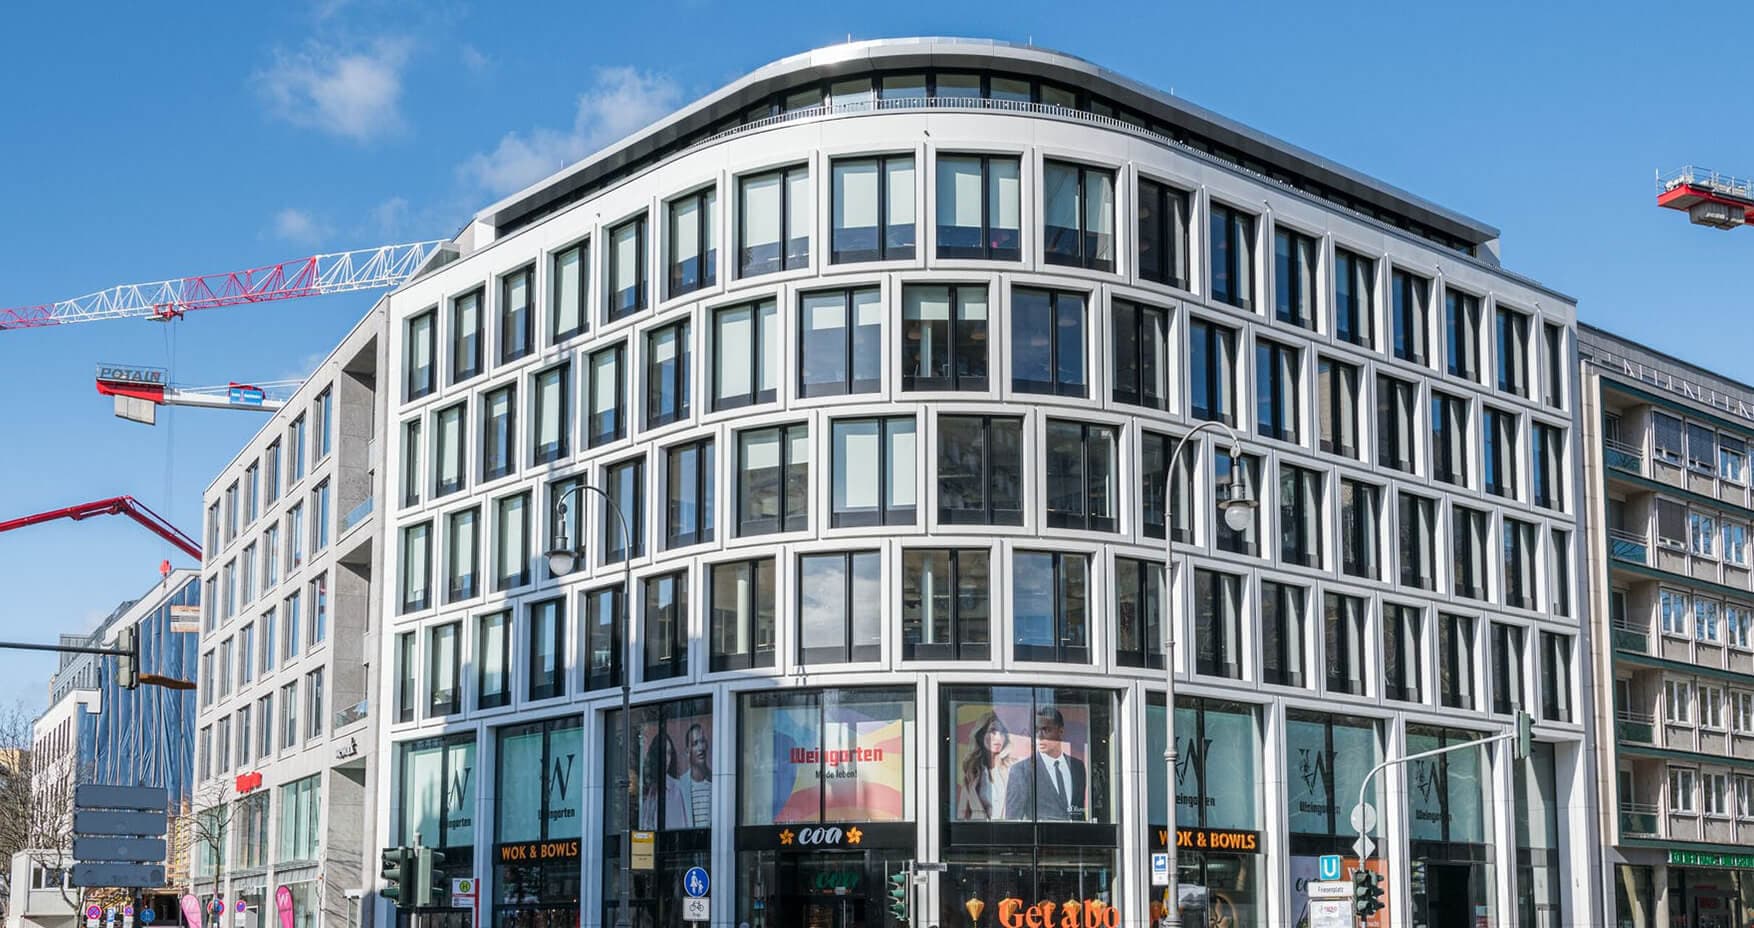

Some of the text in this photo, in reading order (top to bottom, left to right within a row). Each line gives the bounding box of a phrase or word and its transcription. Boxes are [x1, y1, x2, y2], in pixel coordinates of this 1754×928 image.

[100, 366, 161, 383] POTAIN
[815, 770, 835, 779] Mde
[798, 827, 843, 845] coa
[1197, 833, 1207, 848] &
[1211, 833, 1256, 850] BOWLS
[502, 842, 578, 860] WOK & BOWLS
[1323, 858, 1336, 877] U
[998, 898, 1057, 928] Get
[1061, 903, 1082, 928] a
